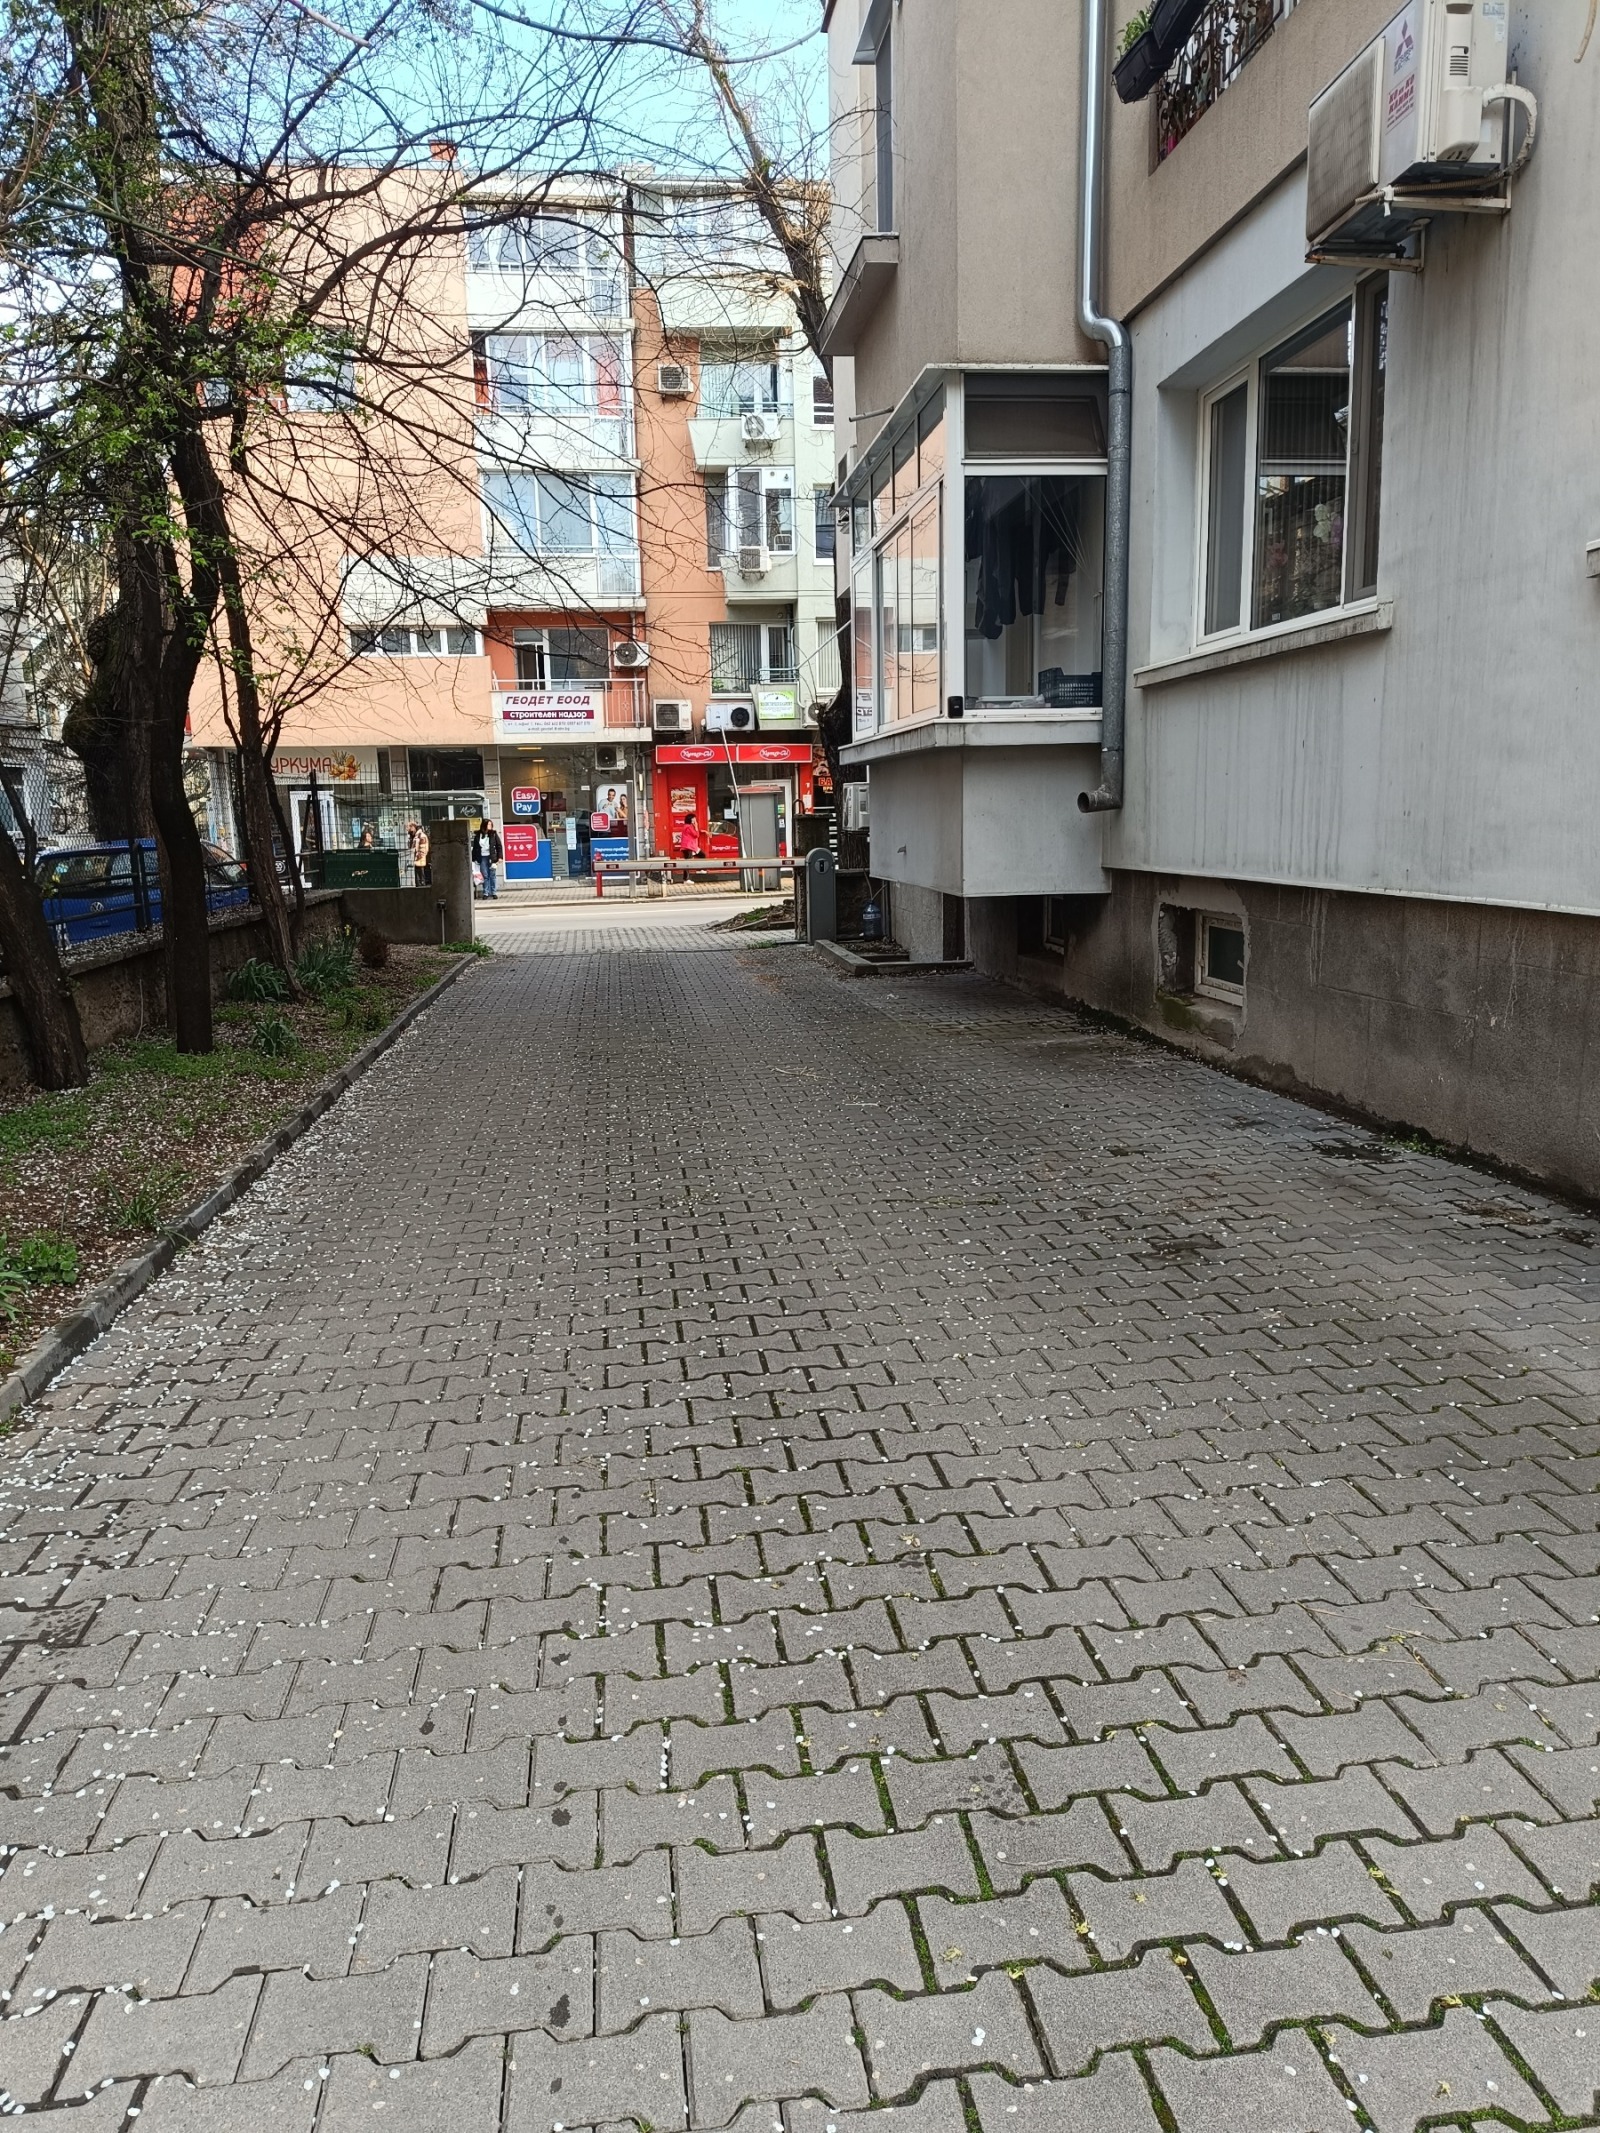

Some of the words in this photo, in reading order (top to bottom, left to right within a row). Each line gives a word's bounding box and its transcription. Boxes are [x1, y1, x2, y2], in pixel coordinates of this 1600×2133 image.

[505, 696, 553, 706] ГЕОДЕТ
[557, 696, 590, 705] ЕООД
[510, 711, 557, 719] строителен
[559, 711, 587, 719] надзор
[270, 757, 332, 774] УРКУМА
[818, 777, 833, 786] БА
[515, 791, 537, 801] Easy
[516, 802, 532, 813] Pay
